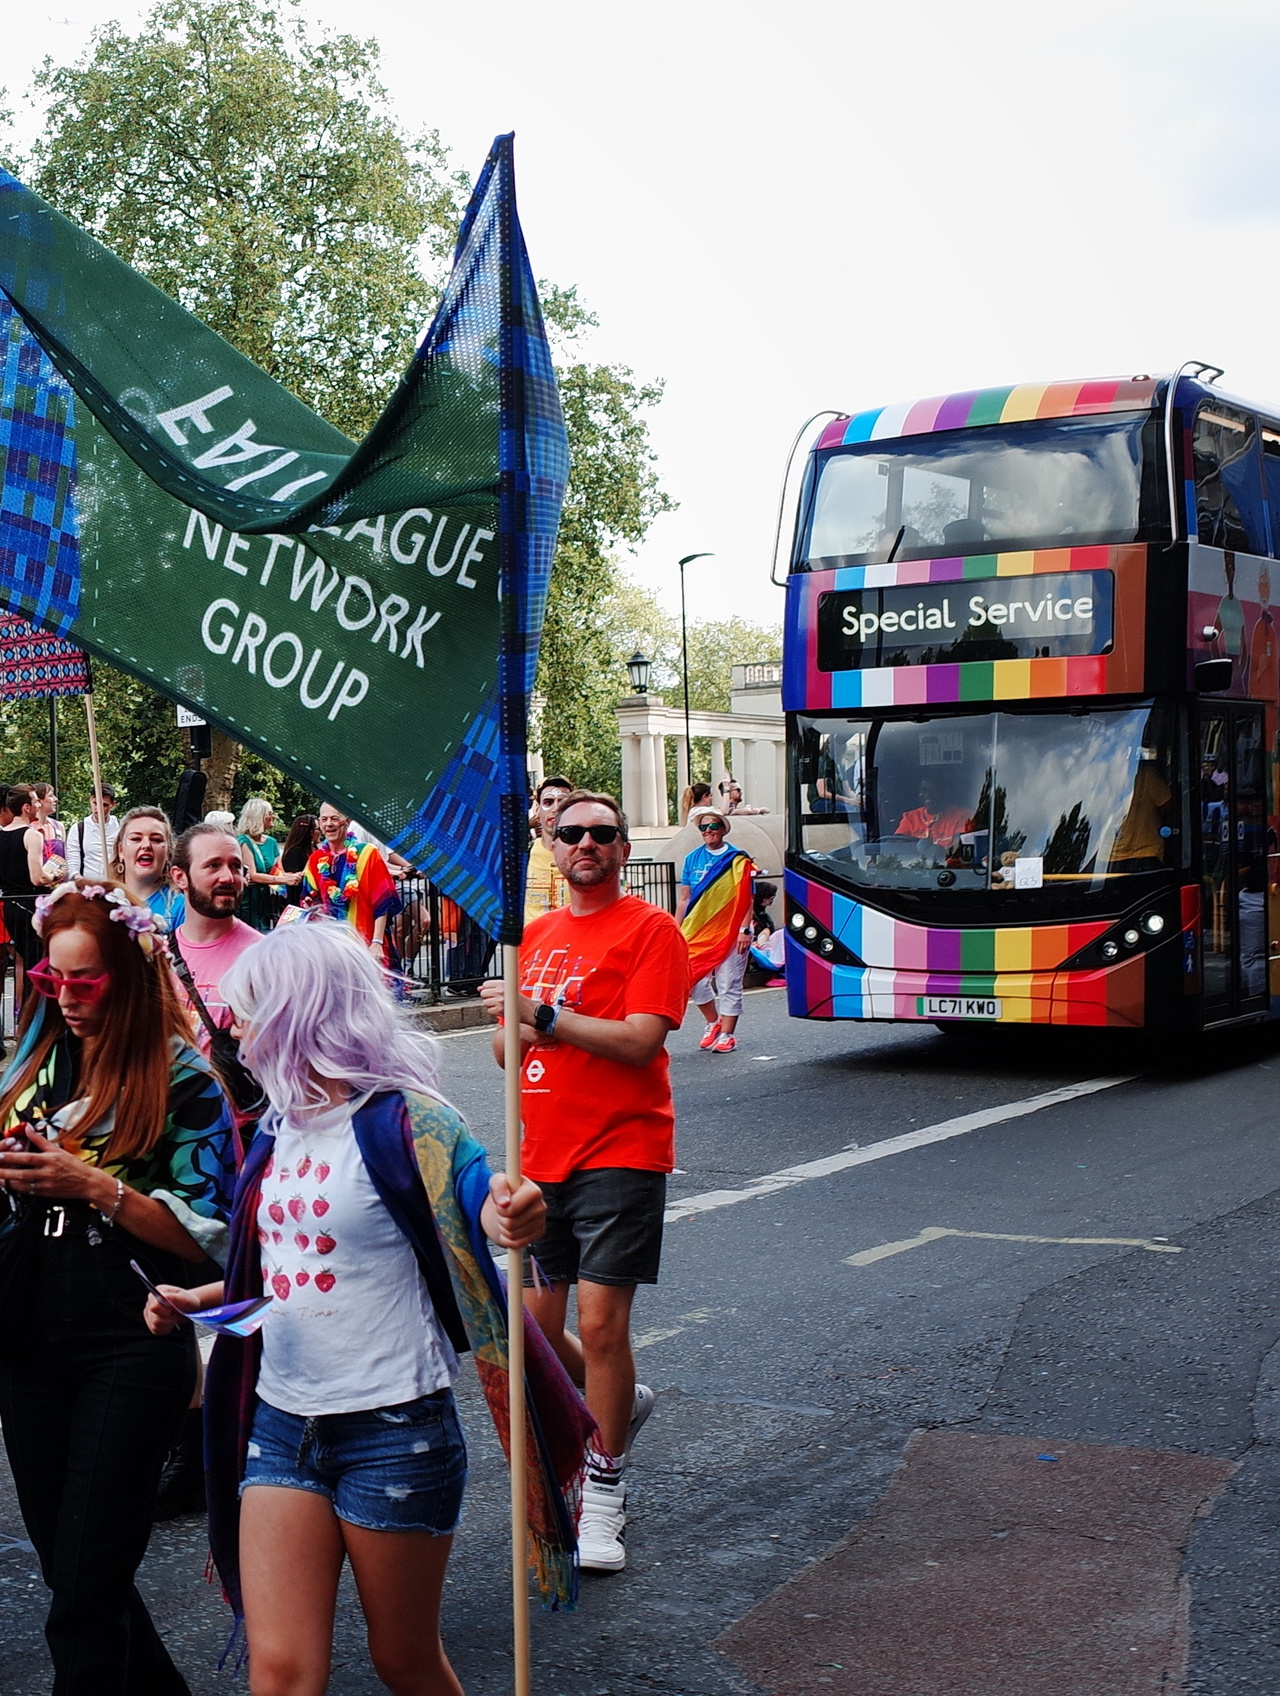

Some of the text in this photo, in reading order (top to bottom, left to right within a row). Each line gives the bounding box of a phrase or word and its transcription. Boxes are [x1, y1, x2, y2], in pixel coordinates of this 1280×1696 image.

[183, 508, 442, 668] NETWORK
[841, 592, 1094, 643] Special Service
[201, 598, 370, 721] GROUP
[180, 714, 202, 723] END
[928, 999, 962, 1014] LC71
